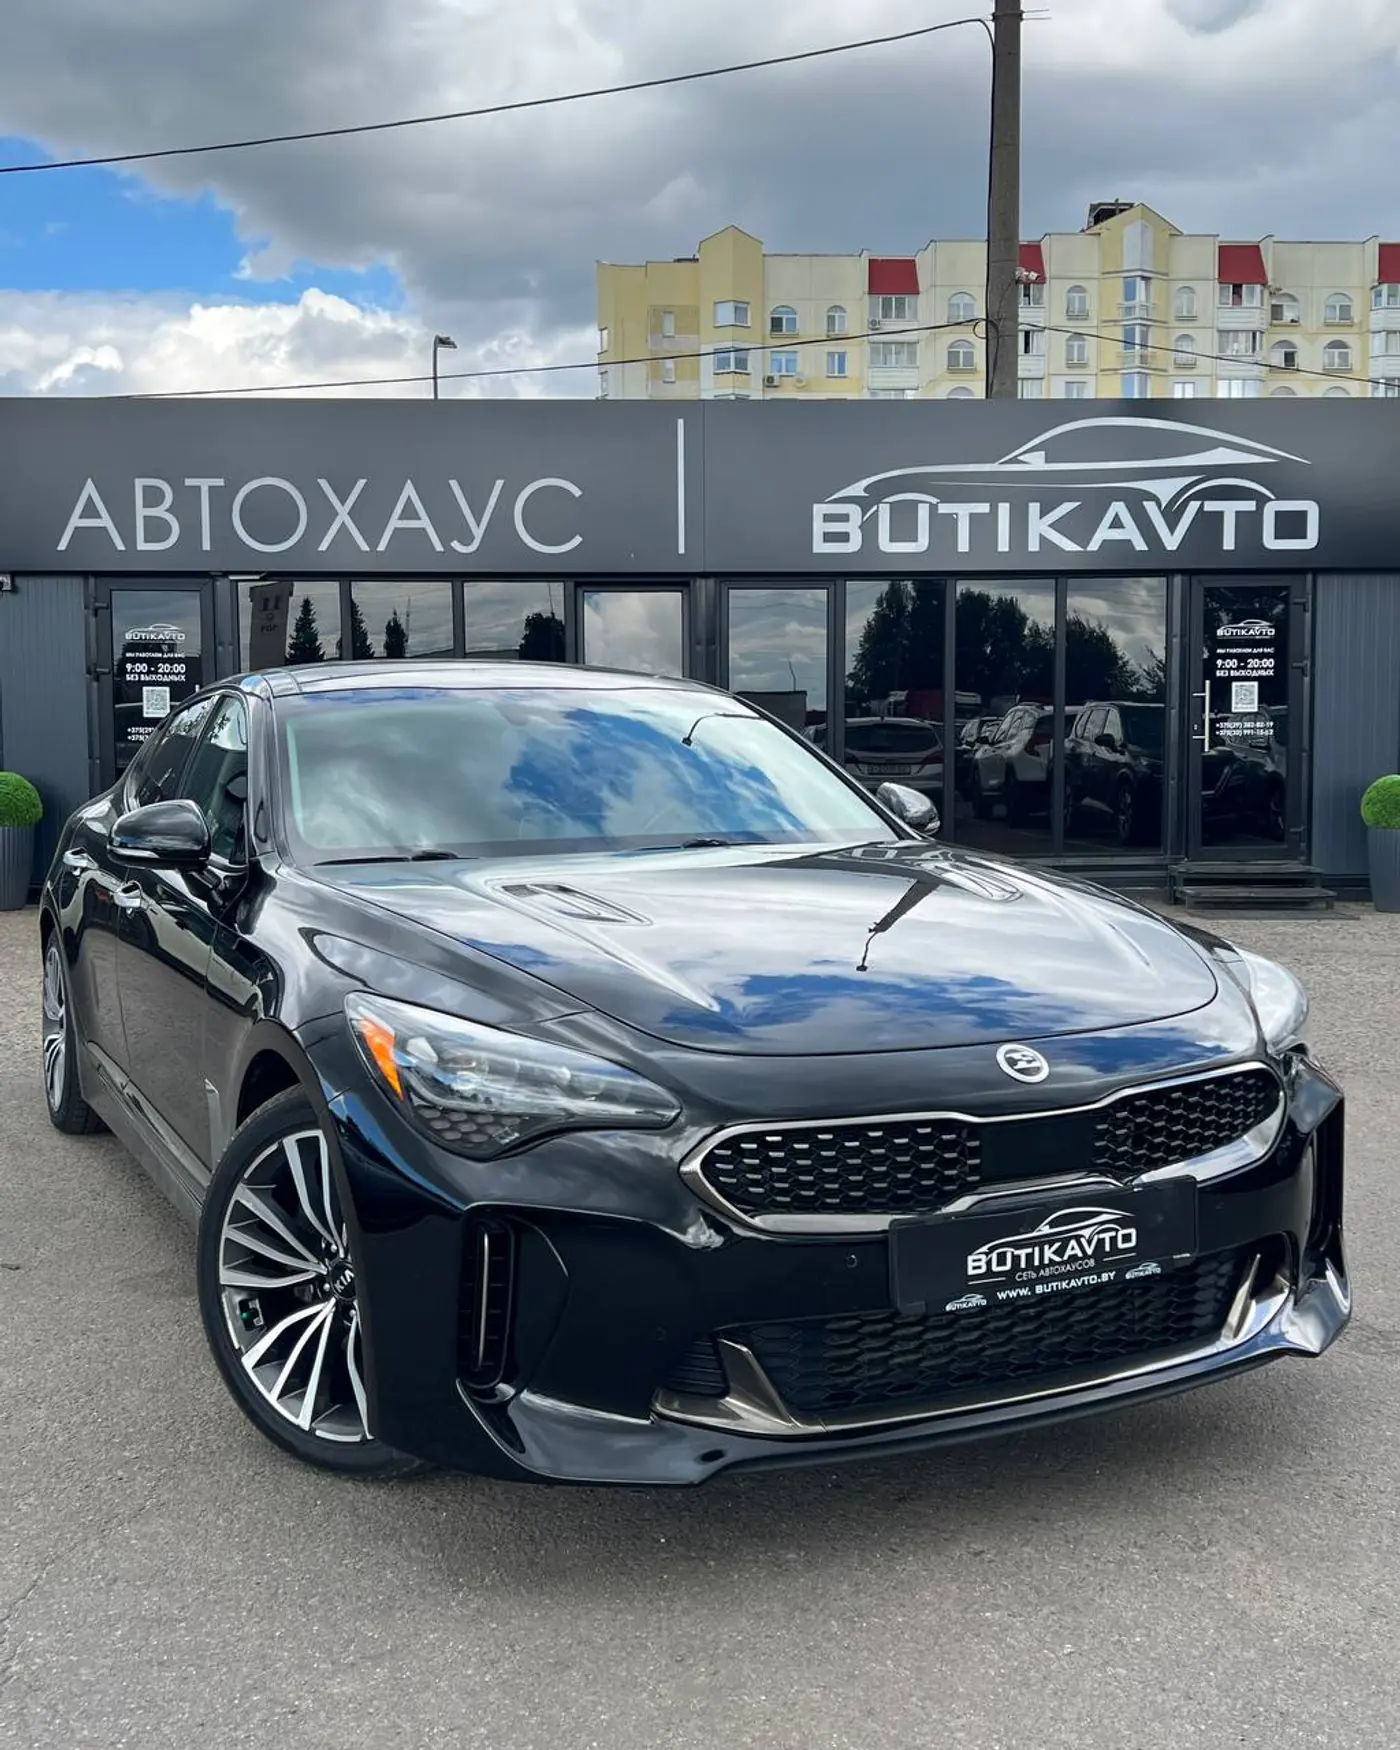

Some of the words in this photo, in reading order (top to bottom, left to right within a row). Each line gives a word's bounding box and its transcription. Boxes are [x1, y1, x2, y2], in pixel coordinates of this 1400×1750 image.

[57, 477, 583, 554] АВТОХАУС
[812, 499, 1320, 554] BUTIKAVTO
[125, 632, 186, 640] BUTIKAVTO
[1216, 628, 1275, 636] BUTIKAVTO
[125, 663, 148, 673] 9:00
[157, 663, 186, 673] 20:00
[1216, 658, 1239, 668] 9:00
[1246, 658, 1275, 668] 20:00
[140, 674, 186, 682] ВЫХОДНЫХ
[1216, 669, 1229, 677] БЕЗ
[1230, 669, 1275, 677] ВЫХОДНЫХ
[966, 1227, 1137, 1276] BUTIKAVTO
[1015, 1270, 1037, 1282] СЕТЬ
[1038, 1257, 1095, 1278] АВТОХАУСОВ
[1125, 1267, 1161, 1279] BUTIKAVTO
[334, 1269, 355, 1293] KIA
[997, 1287, 1032, 1300] WWW.
[1035, 1271, 1116, 1294] BUTIKAVTO.BY
[945, 1299, 987, 1311] BUTIKAVTO
